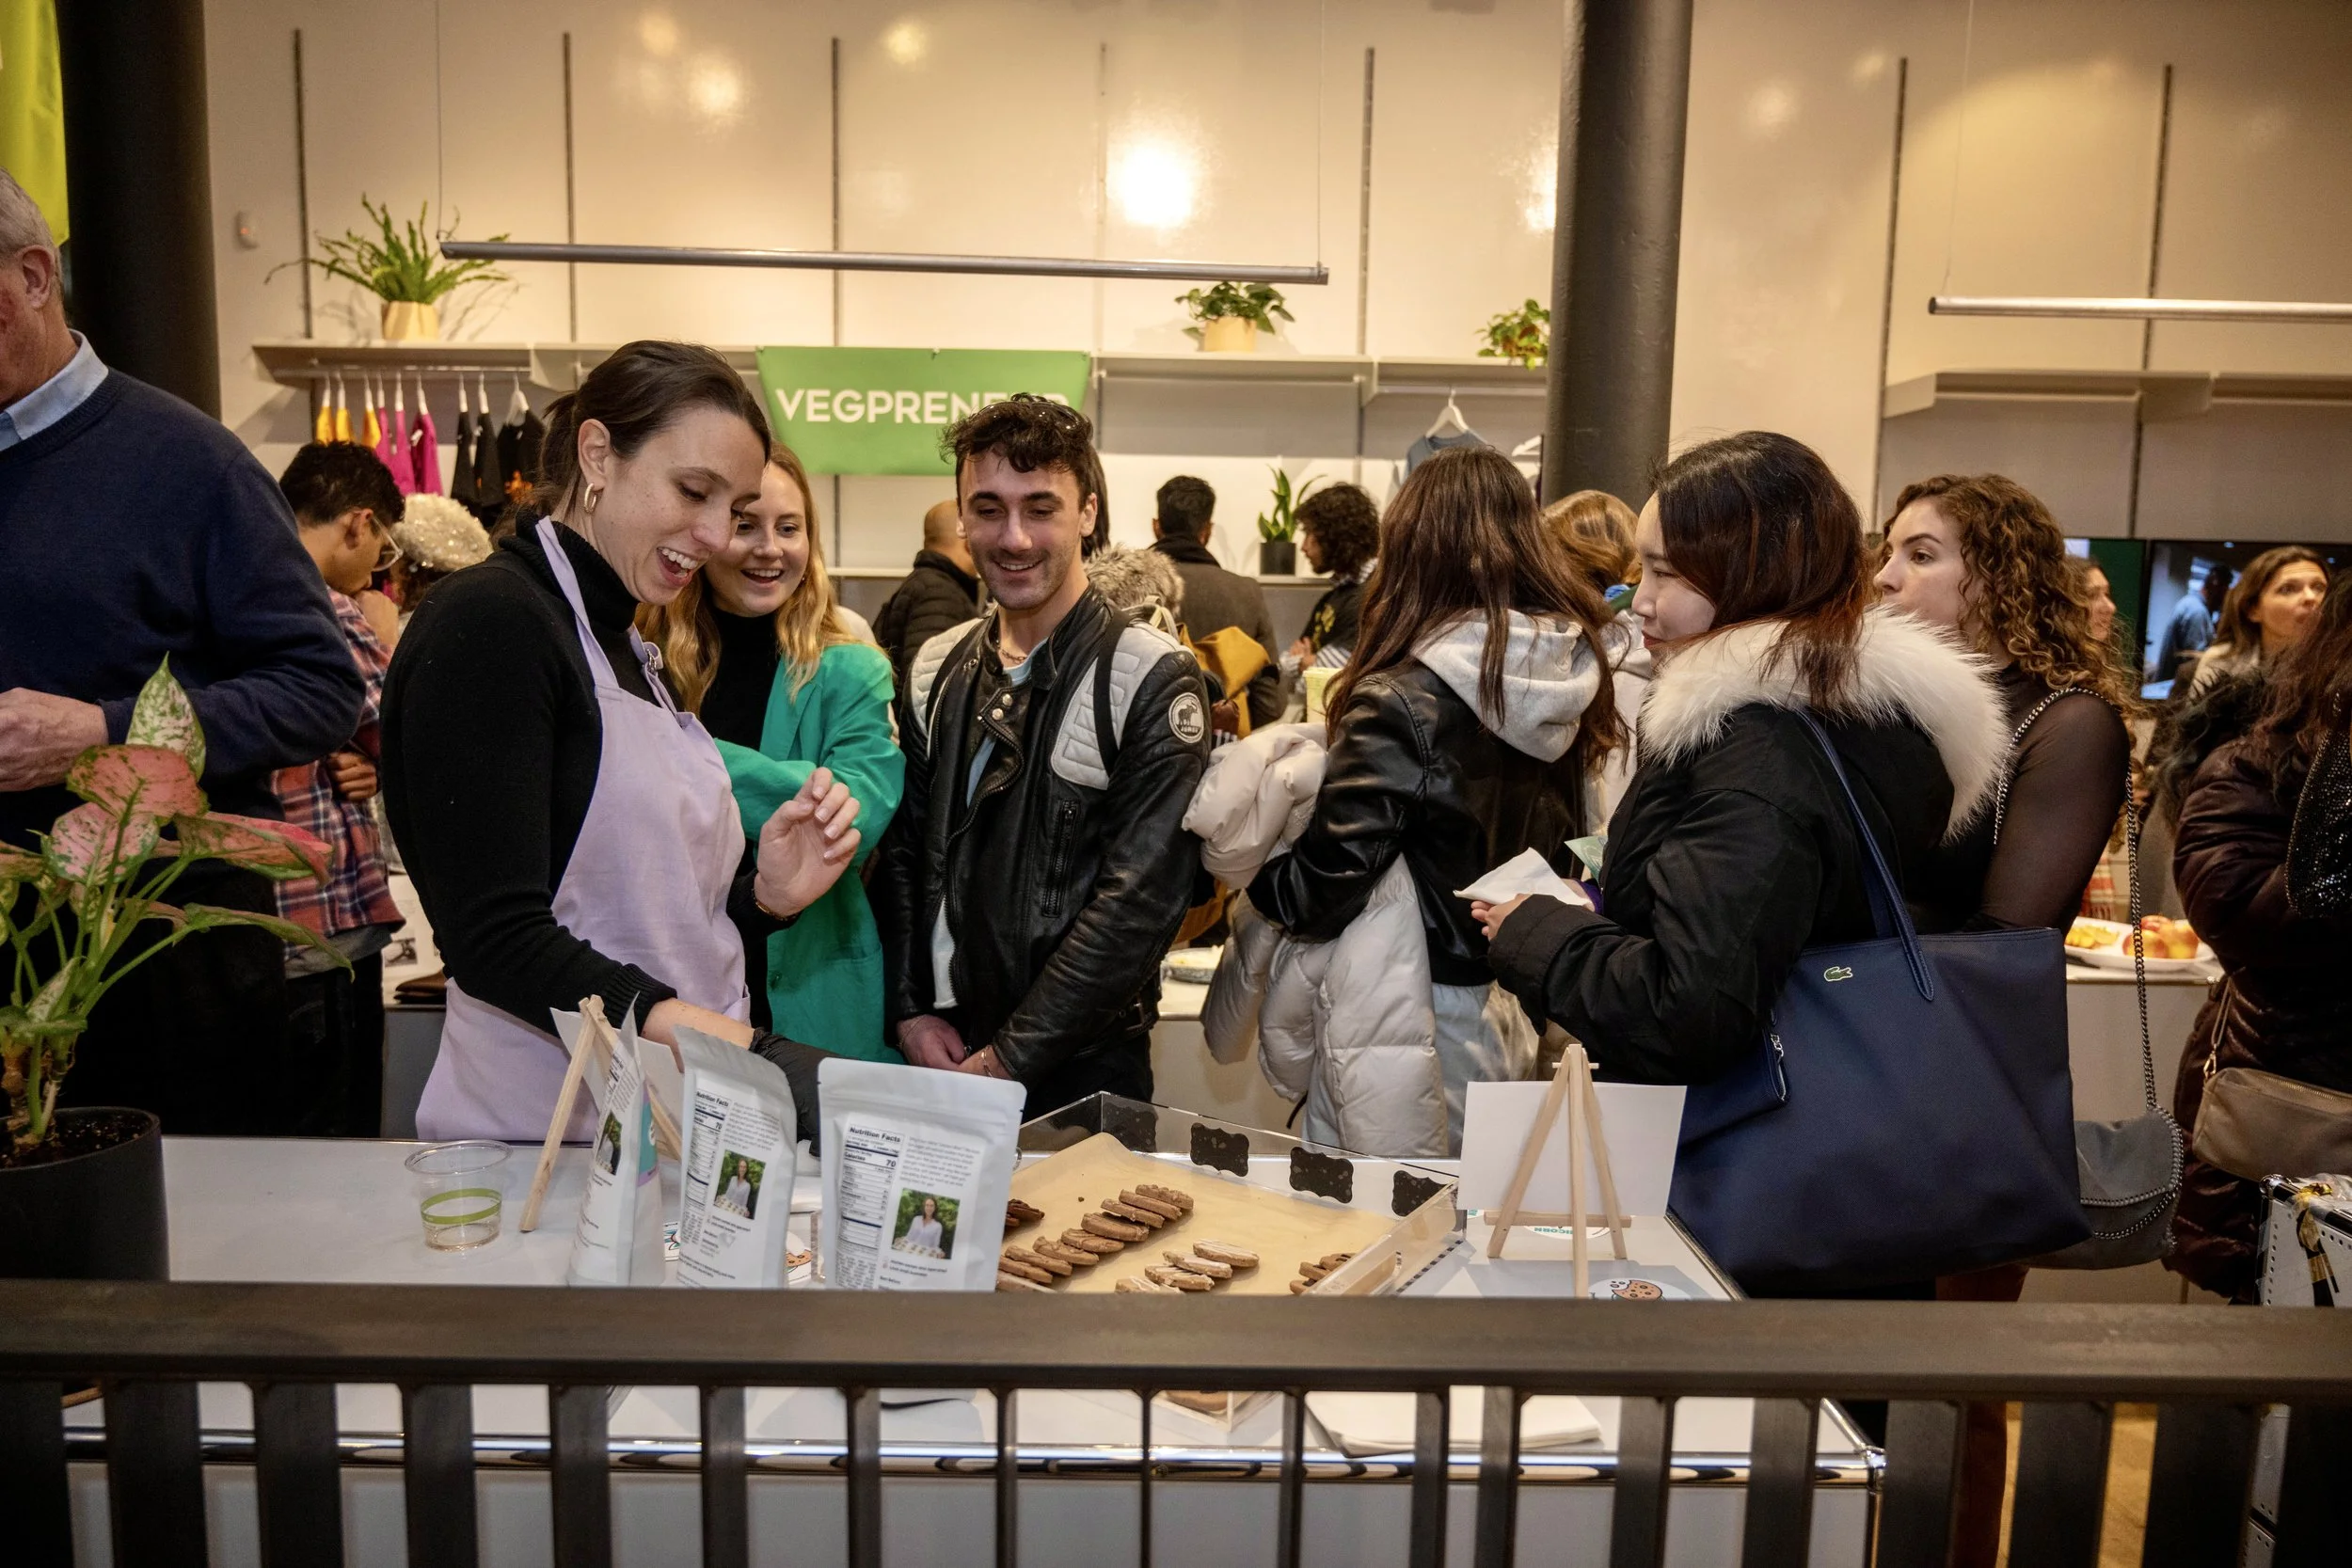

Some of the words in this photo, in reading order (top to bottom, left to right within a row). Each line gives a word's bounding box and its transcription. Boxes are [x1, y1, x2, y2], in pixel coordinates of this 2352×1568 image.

[850, 1127, 880, 1138] Nutrition
[882, 1132, 901, 1144] Facts
[885, 1159, 897, 1168] 70
